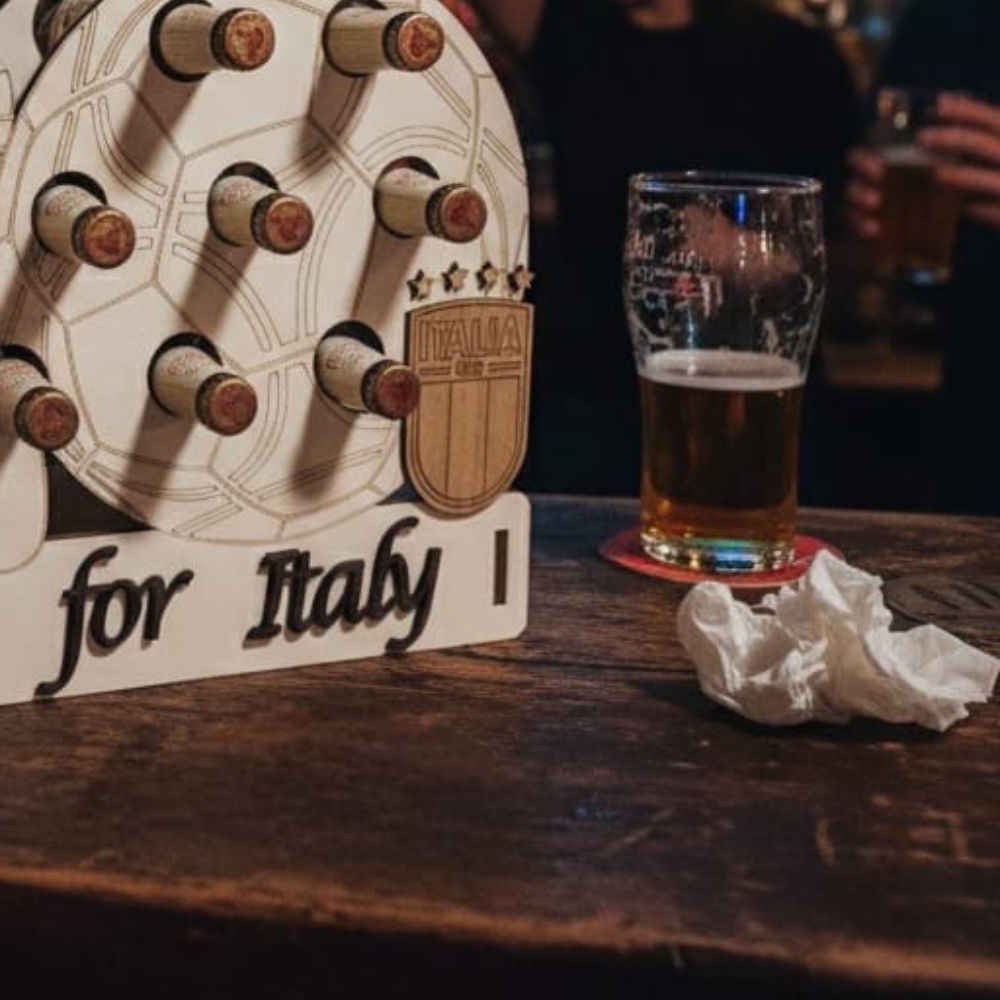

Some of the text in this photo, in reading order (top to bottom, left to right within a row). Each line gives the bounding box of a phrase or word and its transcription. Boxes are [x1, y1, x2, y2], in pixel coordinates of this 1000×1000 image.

[418, 314, 523, 361] ITALIA
[34, 545, 194, 700] for
[242, 515, 442, 655] Italy
